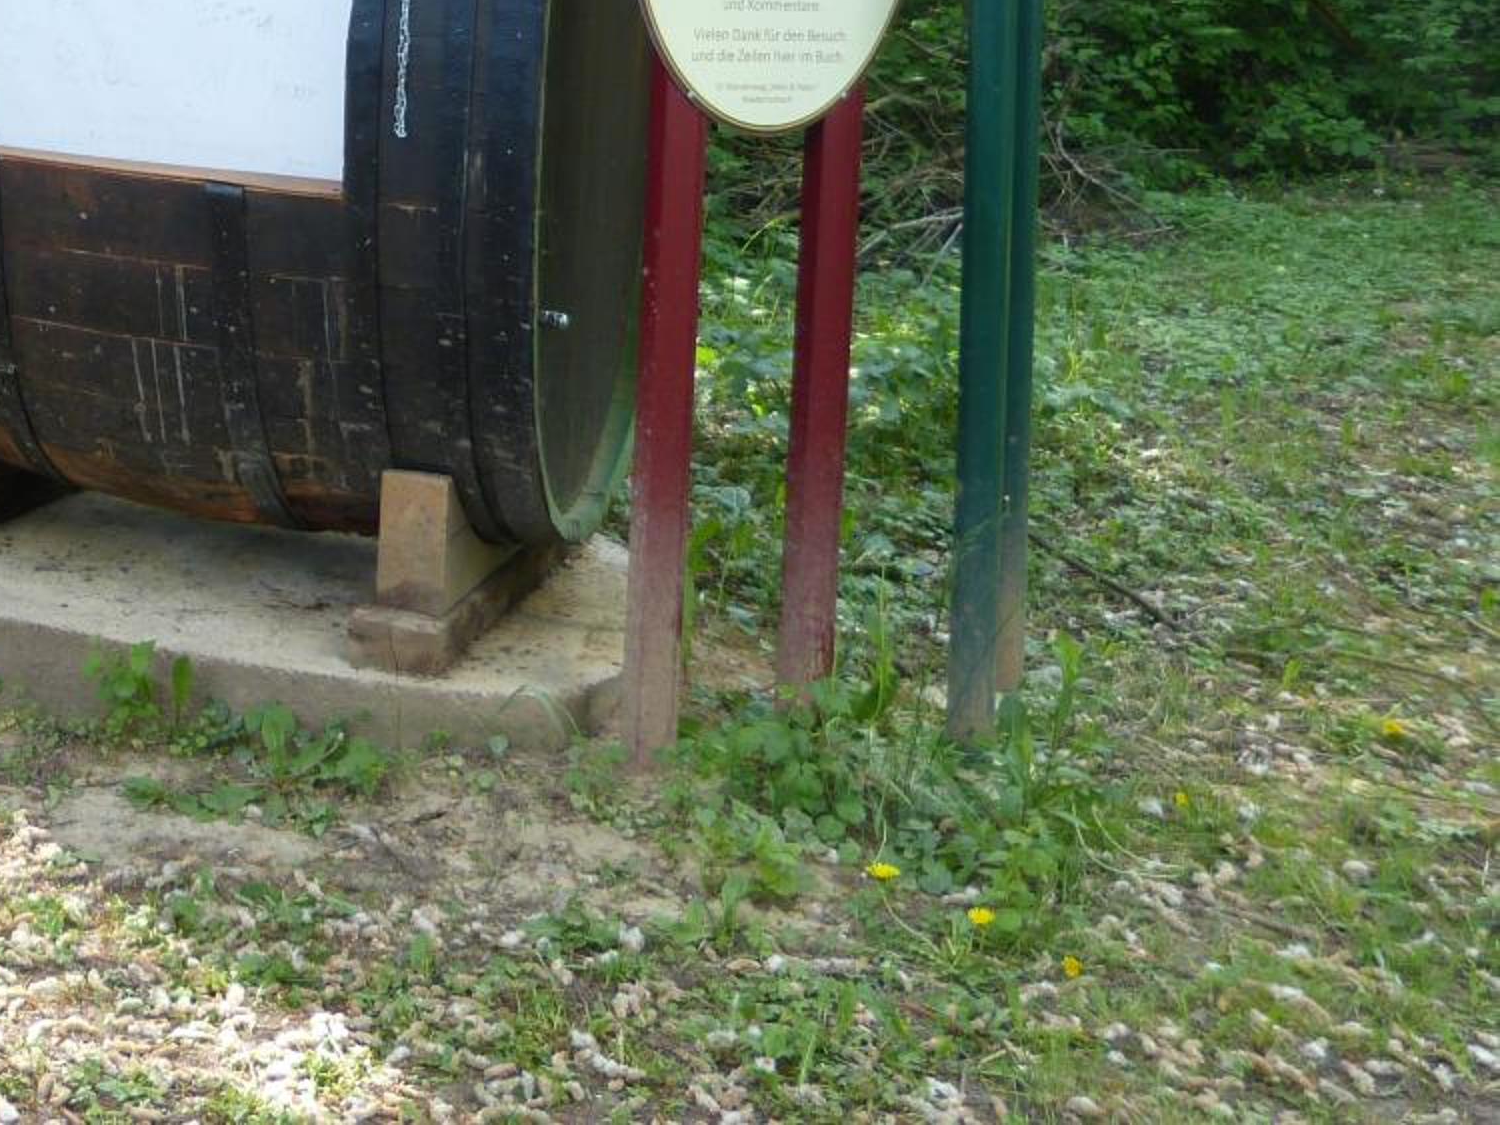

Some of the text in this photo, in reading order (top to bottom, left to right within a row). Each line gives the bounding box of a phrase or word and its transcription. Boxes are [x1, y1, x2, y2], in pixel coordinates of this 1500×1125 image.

[723, 0, 745, 11] und
[694, 27, 729, 41] Vielen
[731, 28, 761, 42] Dank
[764, 28, 780, 42] für
[783, 29, 806, 42] den
[691, 49, 715, 62] und
[717, 49, 734, 62] die
[801, 51, 814, 63] im
